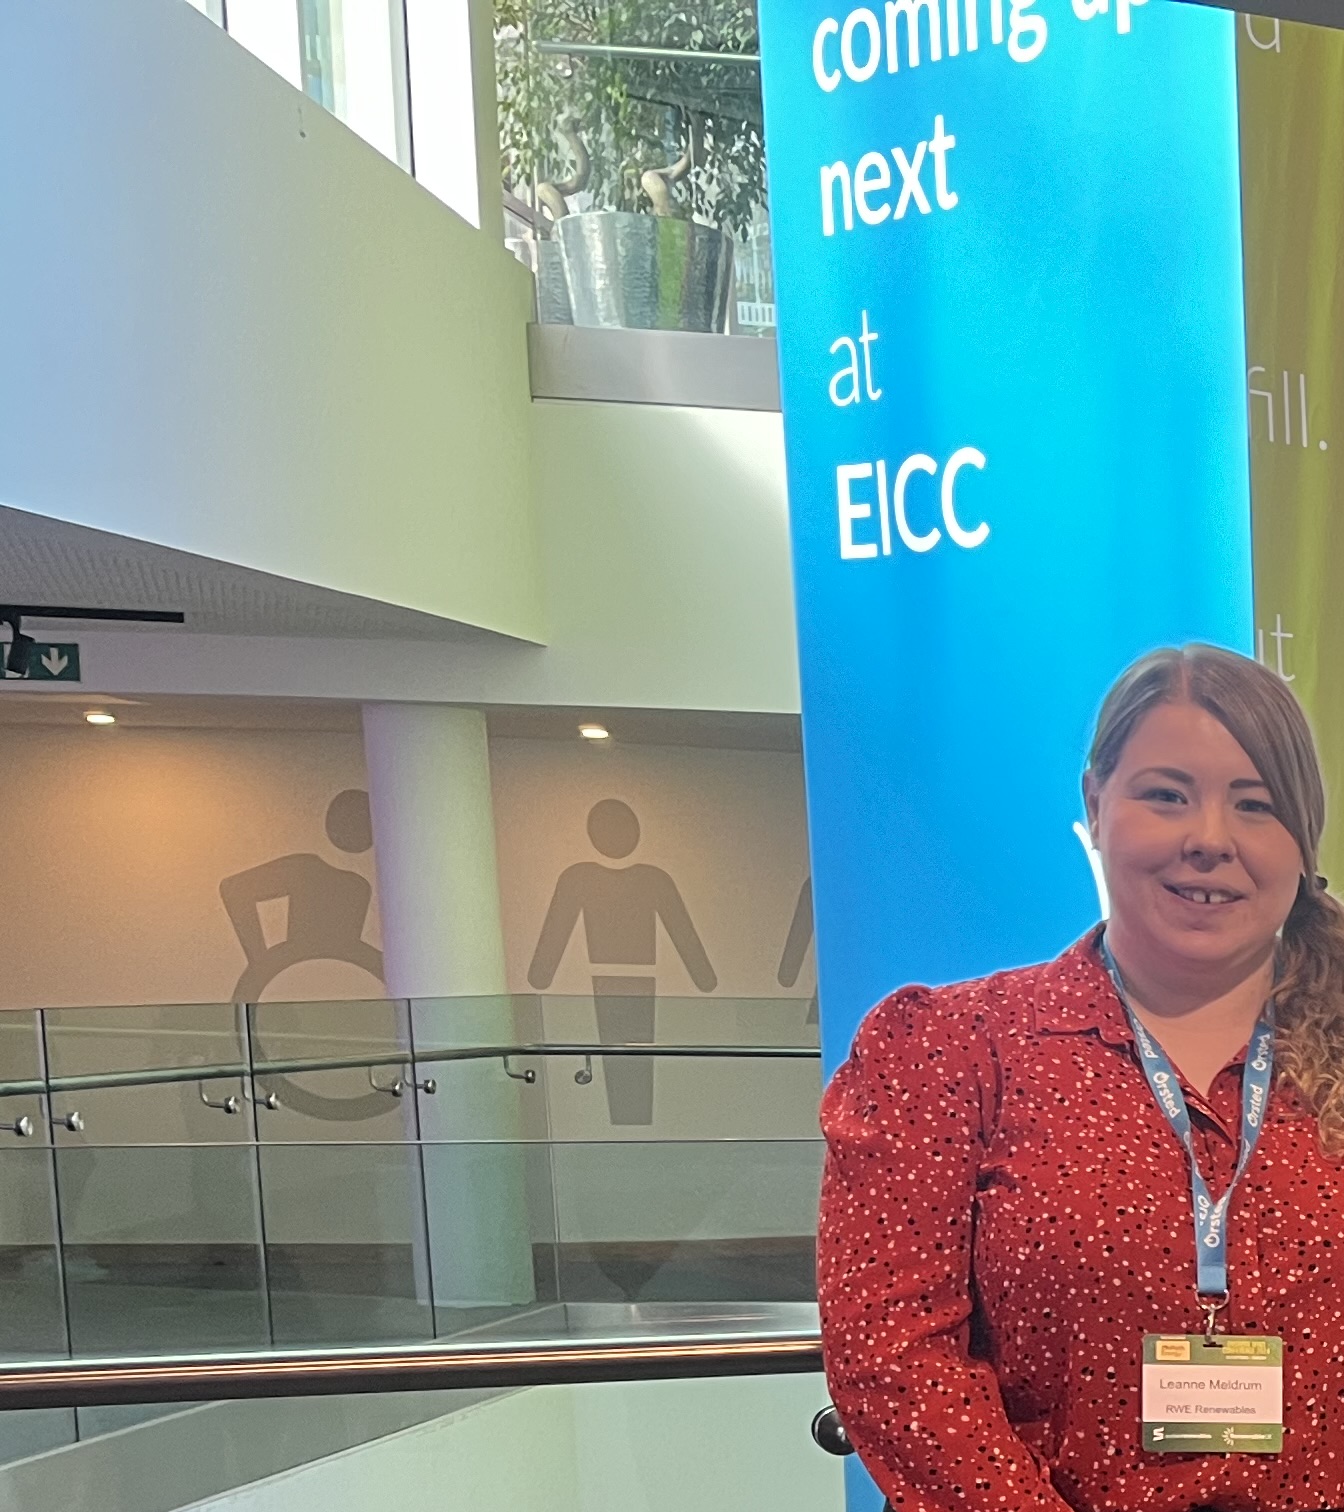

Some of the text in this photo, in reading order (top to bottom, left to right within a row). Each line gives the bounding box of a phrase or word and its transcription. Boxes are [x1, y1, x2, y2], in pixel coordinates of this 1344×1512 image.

[812, 0, 1048, 93] coming
[820, 114, 959, 237] next
[828, 310, 882, 407] at
[836, 446, 990, 560] EICC
[1159, 1378, 1206, 1391] Leanne
[1165, 1404, 1257, 1415] RWE Renewables
